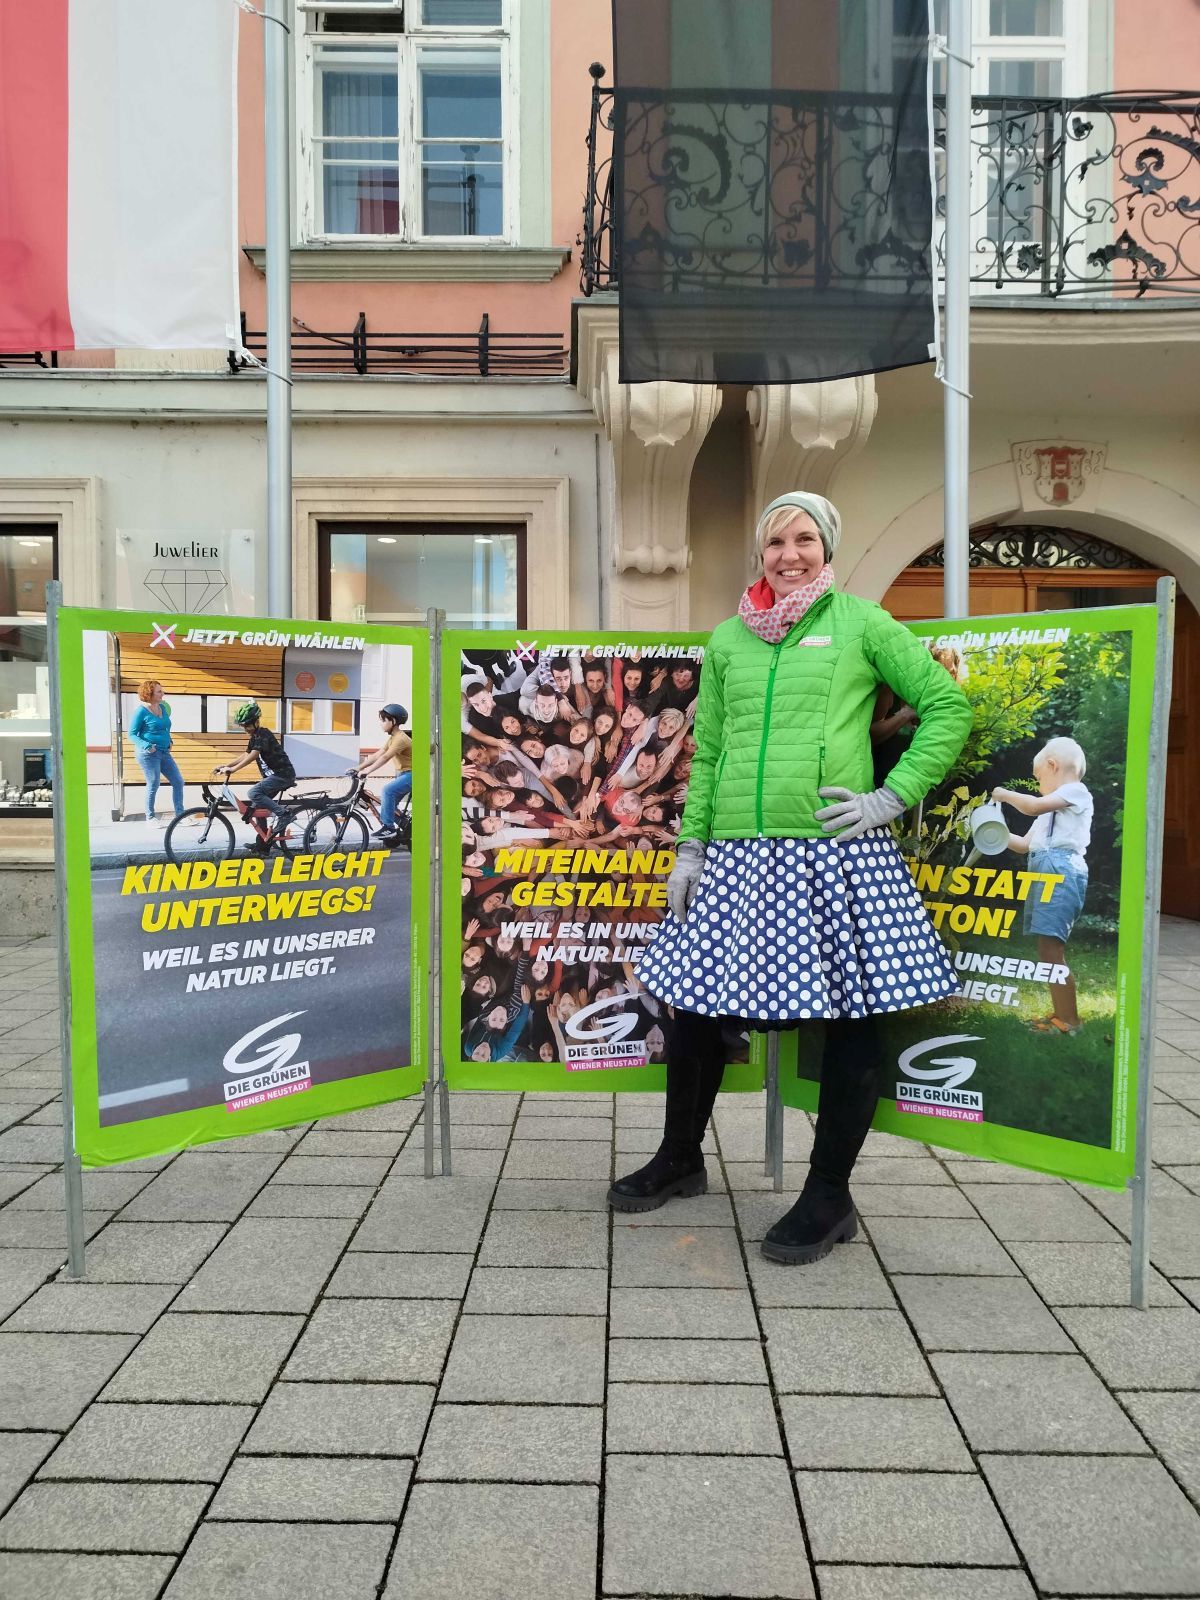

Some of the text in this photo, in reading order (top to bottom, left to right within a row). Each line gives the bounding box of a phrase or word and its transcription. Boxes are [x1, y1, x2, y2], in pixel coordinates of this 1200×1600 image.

[182, 628, 366, 650] JETZT GRÜN WÄHLEN
[541, 644, 590, 658] JETZT
[592, 642, 638, 658] GRÜN
[935, 631, 986, 649] GRÜN
[989, 627, 1071, 646] WÄHLEN
[121, 850, 391, 896] KINDER LEICHT
[494, 849, 676, 874] MITEINAND
[512, 881, 668, 907] GESTALTE
[947, 866, 1065, 903] STATT
[140, 885, 377, 932] UNTERWEGS!
[500, 921, 552, 939] WEIL
[556, 922, 585, 939] ES
[587, 922, 613, 939] IN
[142, 927, 376, 971] WEIL ES IN UNSERER
[536, 945, 609, 962] NATUR
[185, 956, 336, 993] NATUR LIEGT.
[954, 951, 1070, 985] UNSERER
[568, 1044, 642, 1058] DIE GRÜNEN
[571, 1058, 643, 1070] WIENER NEUSTADT
[227, 1065, 307, 1096] DIE GRÜNEN
[231, 1081, 308, 1110] WIENER NEUSTADT
[899, 1085, 979, 1107] DIE GRÜNEN
[902, 1103, 980, 1121] WIENER NEUSTADT
